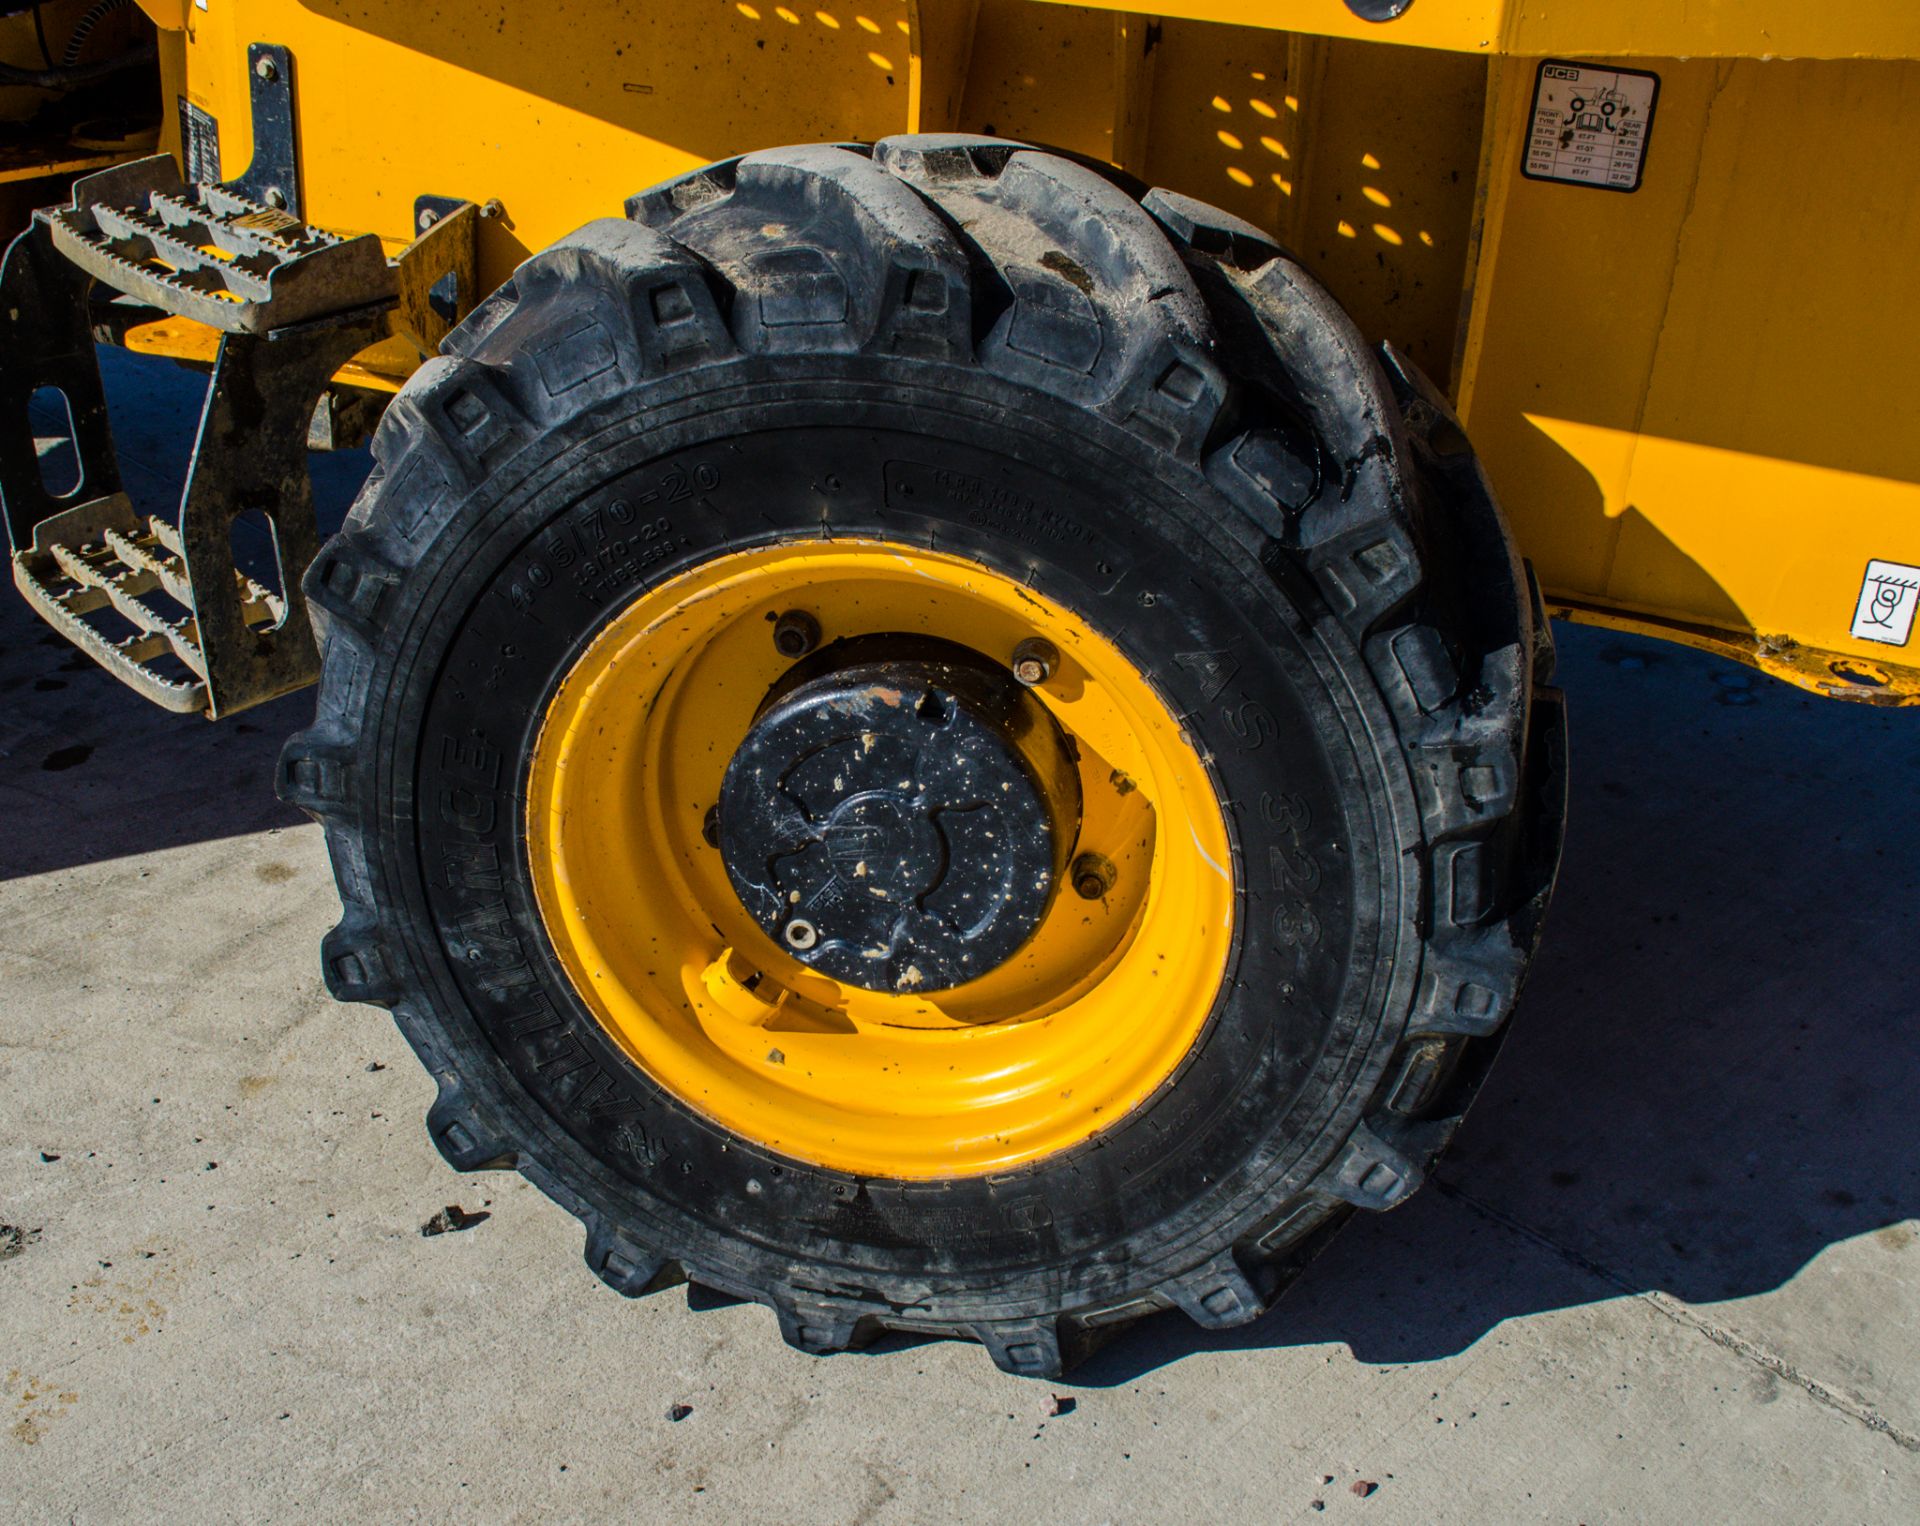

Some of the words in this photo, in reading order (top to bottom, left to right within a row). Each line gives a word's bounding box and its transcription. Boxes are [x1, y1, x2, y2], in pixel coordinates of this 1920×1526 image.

[1544, 66, 1579, 81] JCB
[511, 462, 720, 609] 405/70-20
[572, 517, 672, 587] 16/70-20
[596, 541, 677, 595] TUBELESS
[1260, 791, 1322, 947] 323
[441, 734, 645, 1118] ALLIANCE
